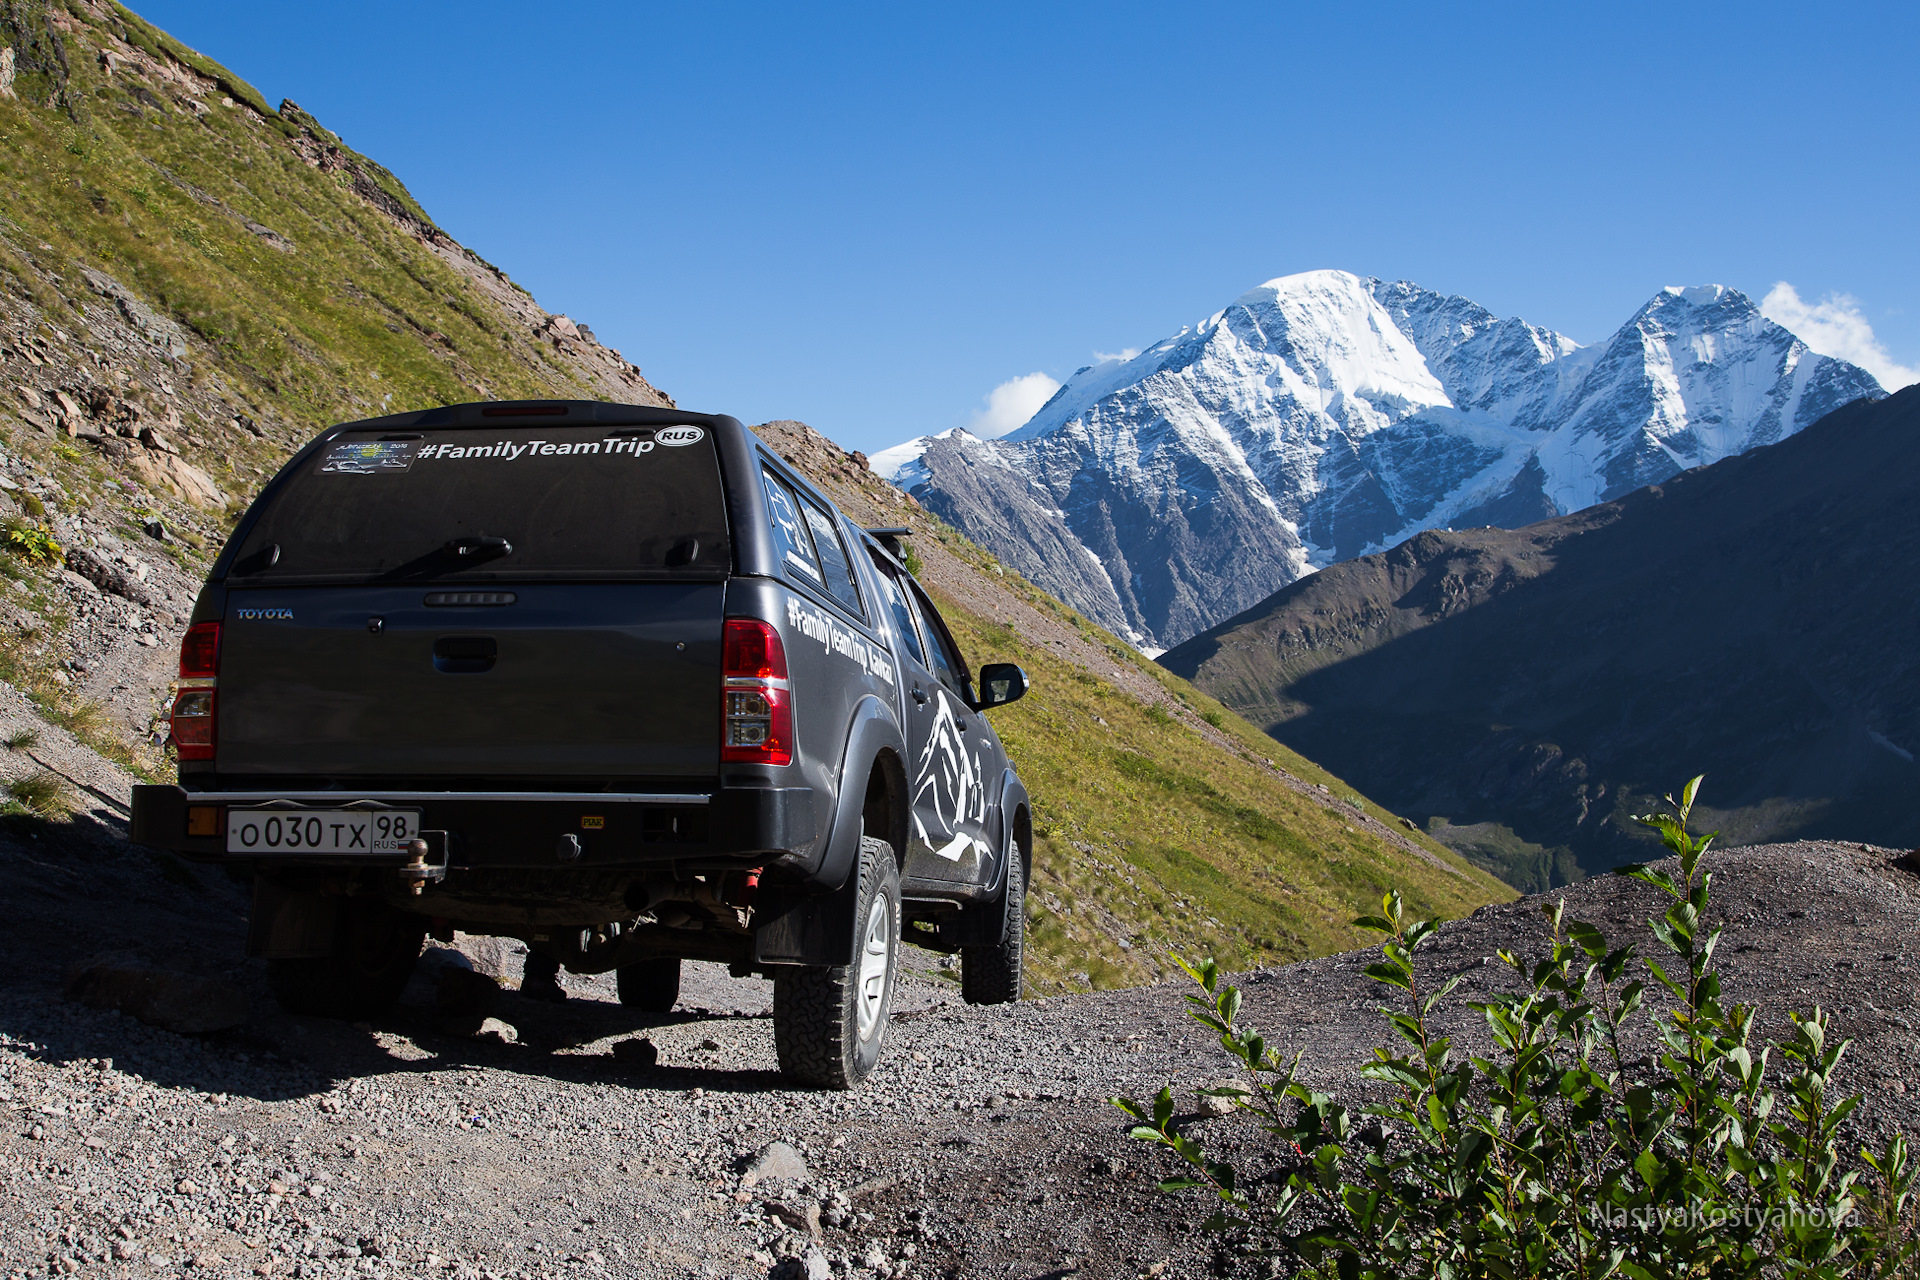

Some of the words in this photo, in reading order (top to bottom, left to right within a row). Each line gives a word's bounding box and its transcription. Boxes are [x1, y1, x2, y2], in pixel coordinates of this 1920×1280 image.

[660, 430, 698, 441] RUS
[417, 437, 655, 461] #FamilyTeamTrip
[237, 608, 294, 620] TOYOTA
[376, 816, 407, 840] 98
[373, 840, 398, 849] RUS
